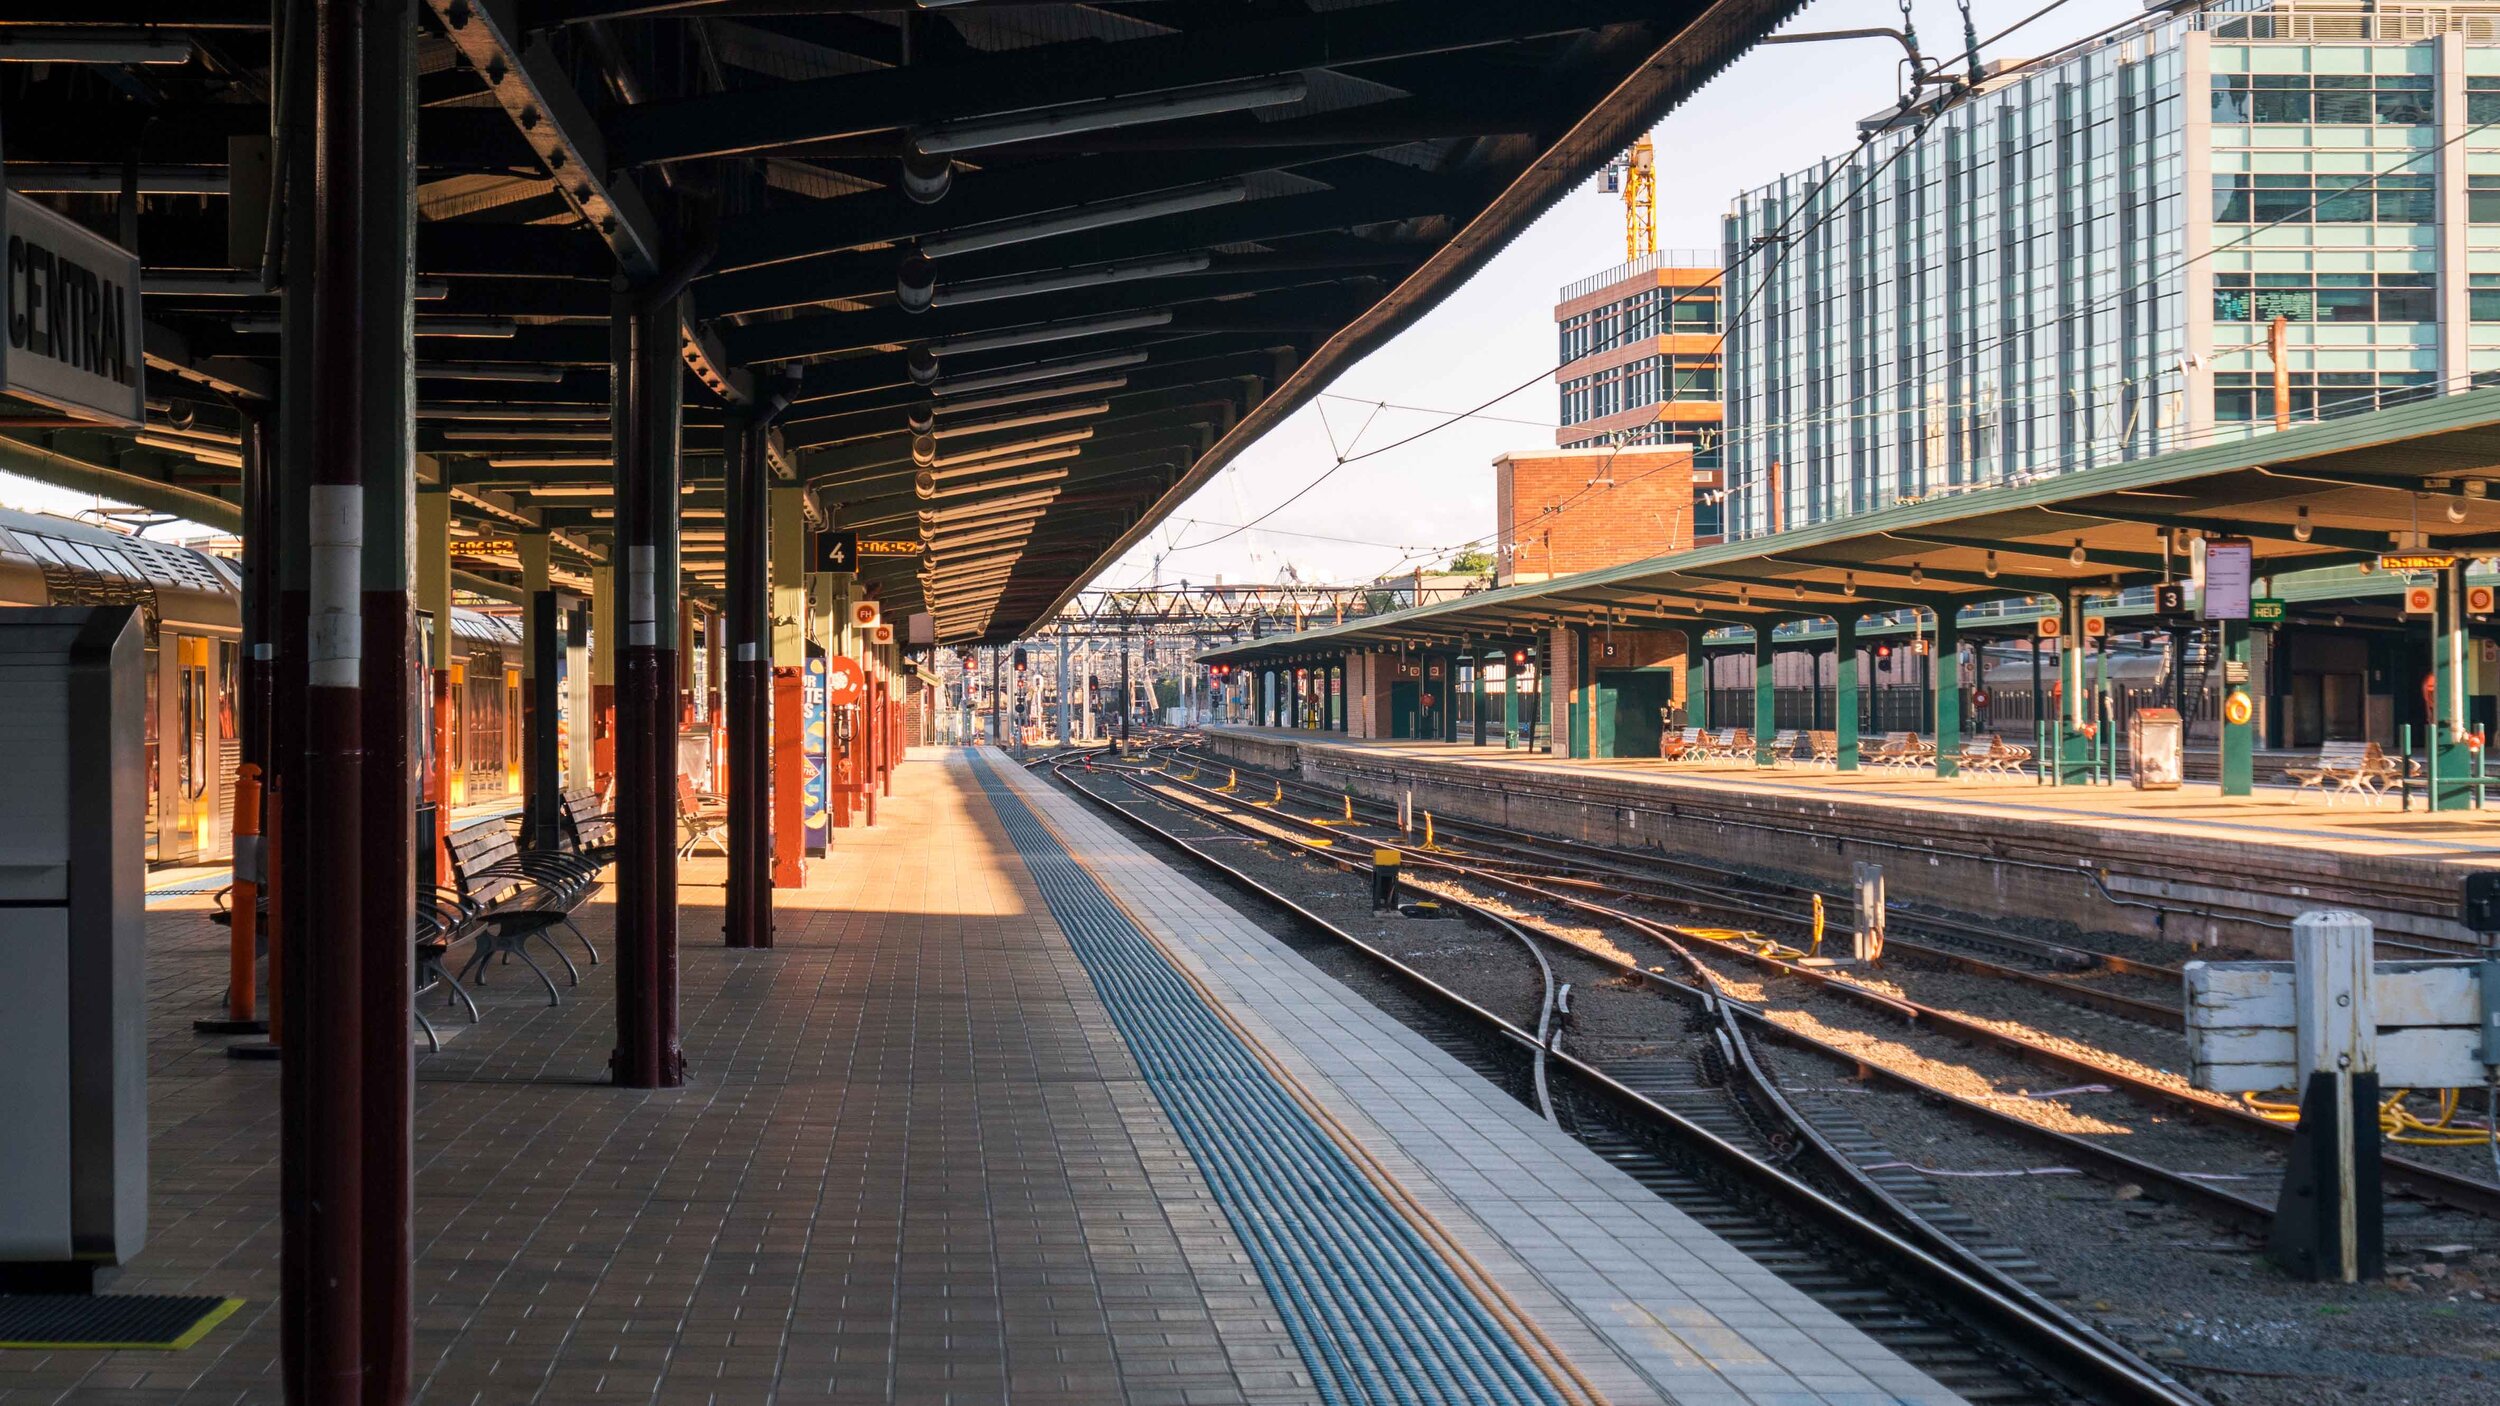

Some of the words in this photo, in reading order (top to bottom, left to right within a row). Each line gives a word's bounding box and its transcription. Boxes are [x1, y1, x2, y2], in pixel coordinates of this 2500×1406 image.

[8, 235, 136, 388] CENTRAL
[829, 542, 845, 563] 4
[2165, 592, 2177, 607] 3
[2254, 607, 2282, 618] HELP
[1607, 646, 1614, 655] 3
[1914, 643, 1923, 653] 2
